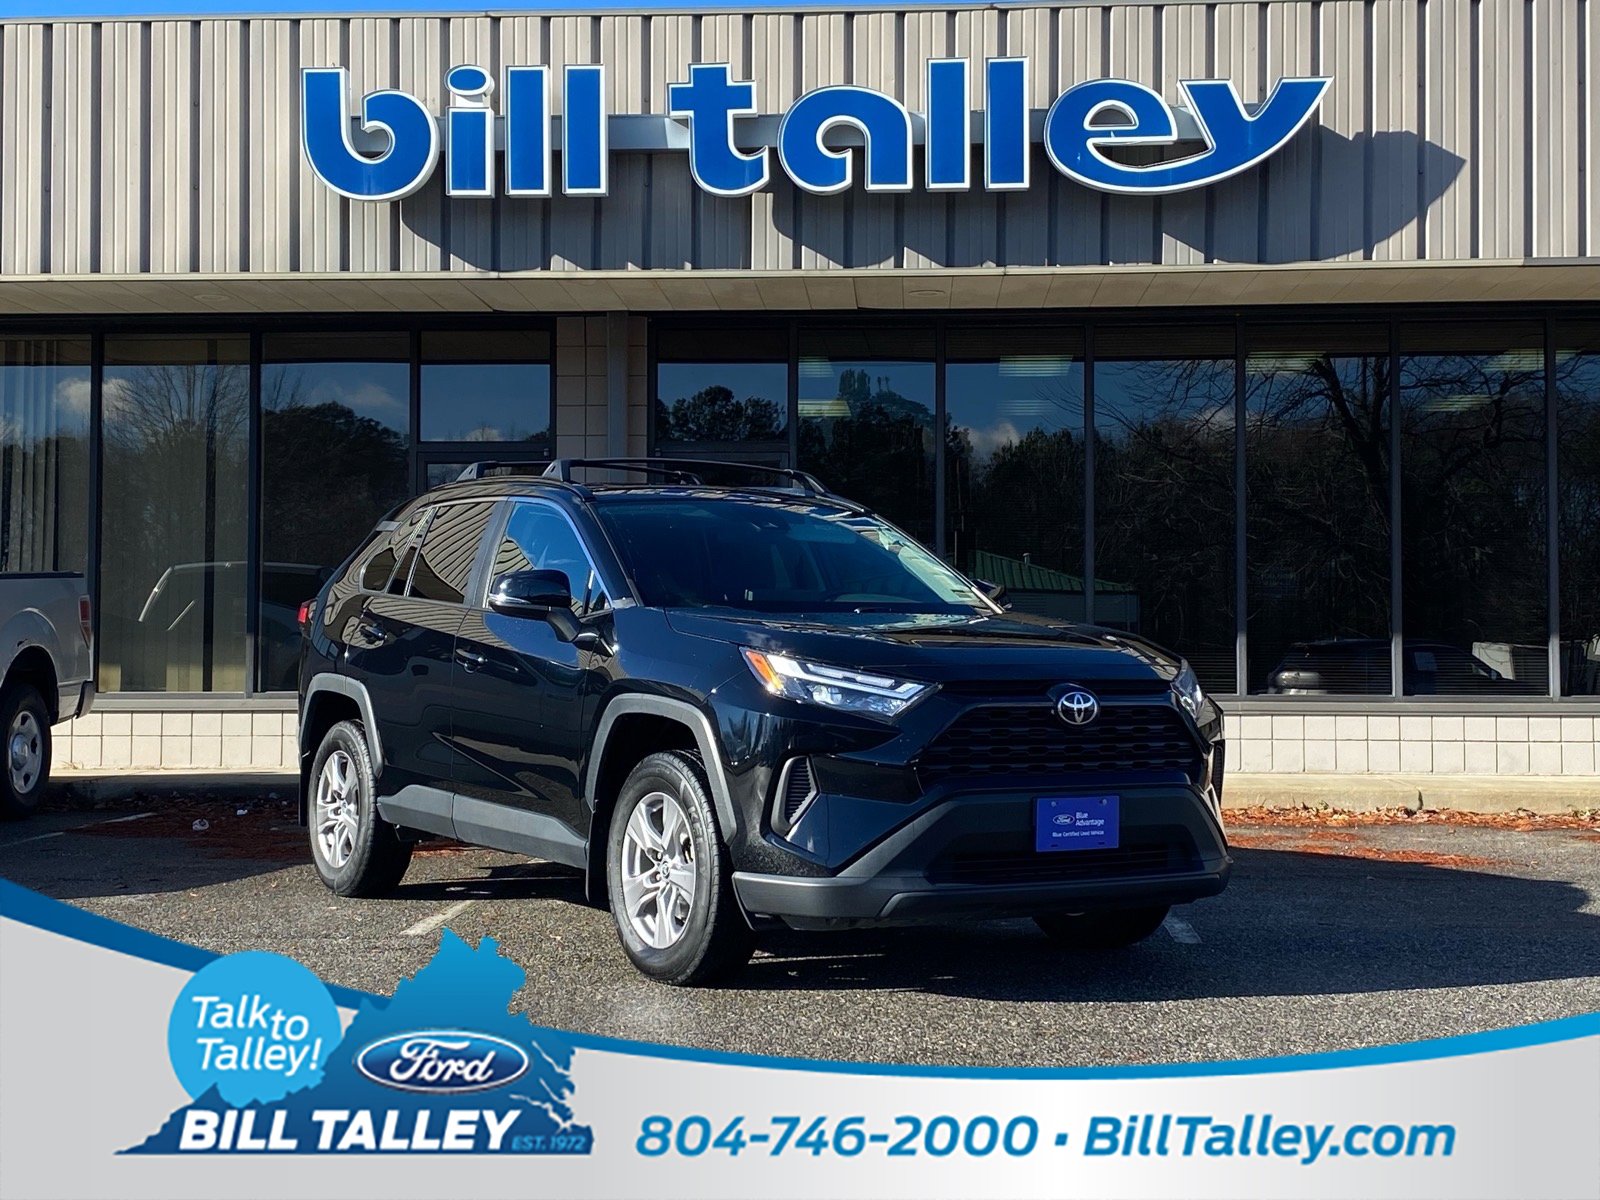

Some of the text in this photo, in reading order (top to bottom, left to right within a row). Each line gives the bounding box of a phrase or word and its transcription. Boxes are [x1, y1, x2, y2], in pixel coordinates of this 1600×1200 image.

[299, 54, 1335, 200] bill talley
[1076, 819, 1105, 827] Advantage
